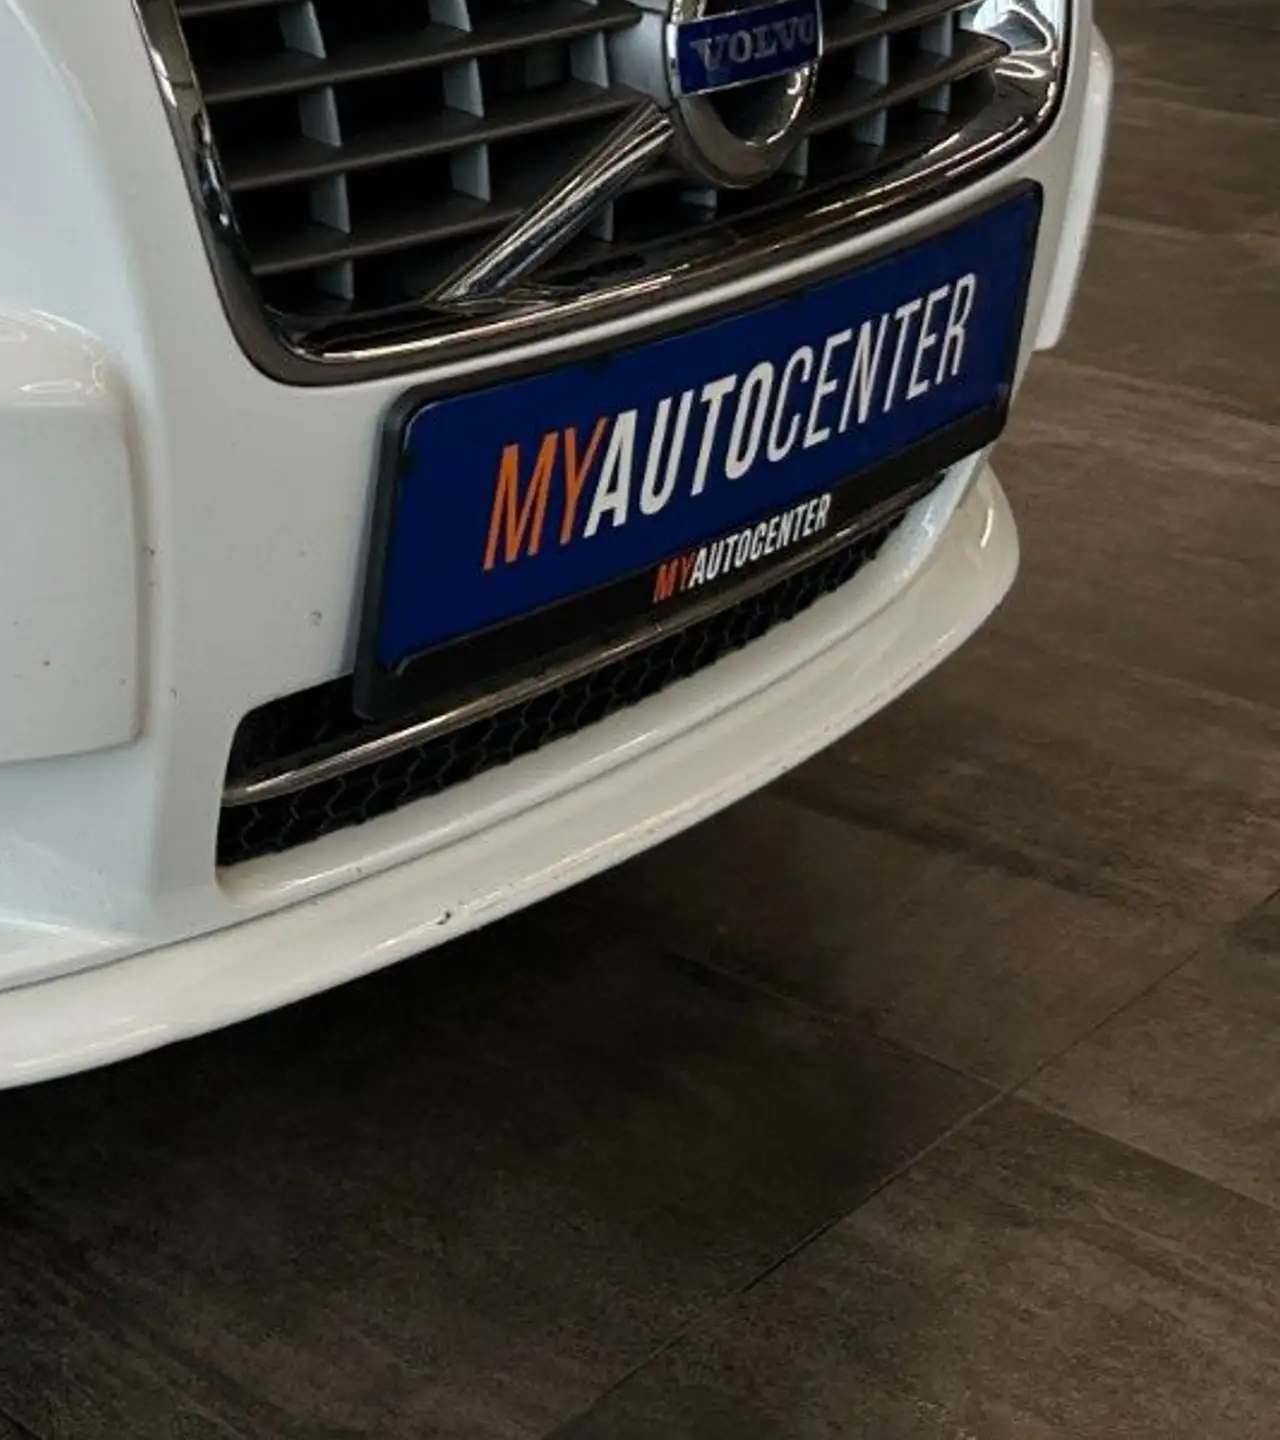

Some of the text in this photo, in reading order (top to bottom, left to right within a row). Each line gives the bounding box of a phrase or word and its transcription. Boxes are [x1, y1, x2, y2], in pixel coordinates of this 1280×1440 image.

[690, 12, 815, 71] VOLVO
[482, 272, 977, 572] MYAUTOCENTER
[652, 493, 832, 603] MYAUTOCENTER
